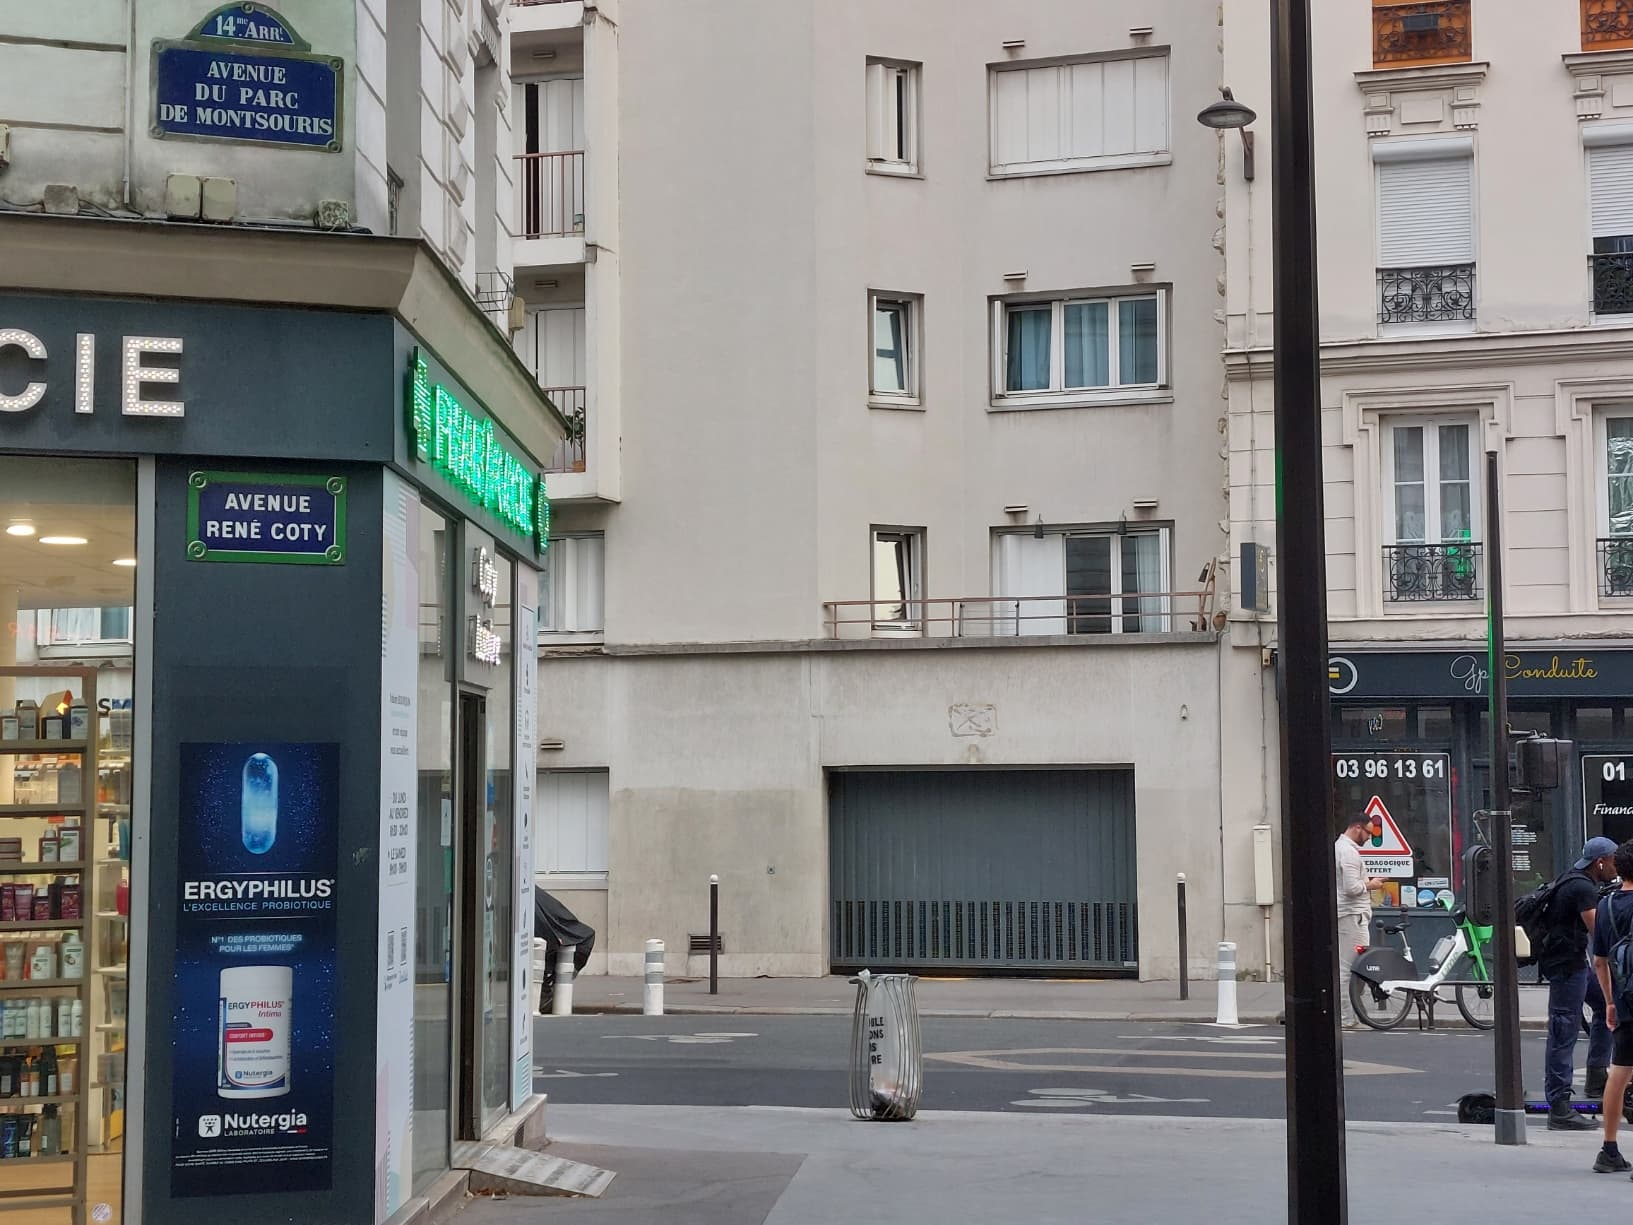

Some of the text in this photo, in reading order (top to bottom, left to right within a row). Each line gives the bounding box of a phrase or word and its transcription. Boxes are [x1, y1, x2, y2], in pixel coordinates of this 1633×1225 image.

[207, 61, 286, 84] AVENUE
[195, 83, 298, 109] DU PARC
[160, 103, 333, 135] DE MONTSOURIS
[224, 493, 311, 513] AVENUE
[206, 519, 327, 541] RENÉ COTY
[1504, 654, 1599, 679] Conduite
[1336, 759, 1444, 778] 03 96 13 61
[1602, 761, 1625, 782] 01
[183, 900, 331, 912] L'EXCELLENCE PROBIOTIQUE
[219, 945, 241, 953] POUR
[228, 935, 243, 943] DES
[244, 934, 303, 943] PROBIOTIQUES
[224, 1108, 307, 1131] Nutergia
[224, 1129, 275, 1137] LABORATOIRE
